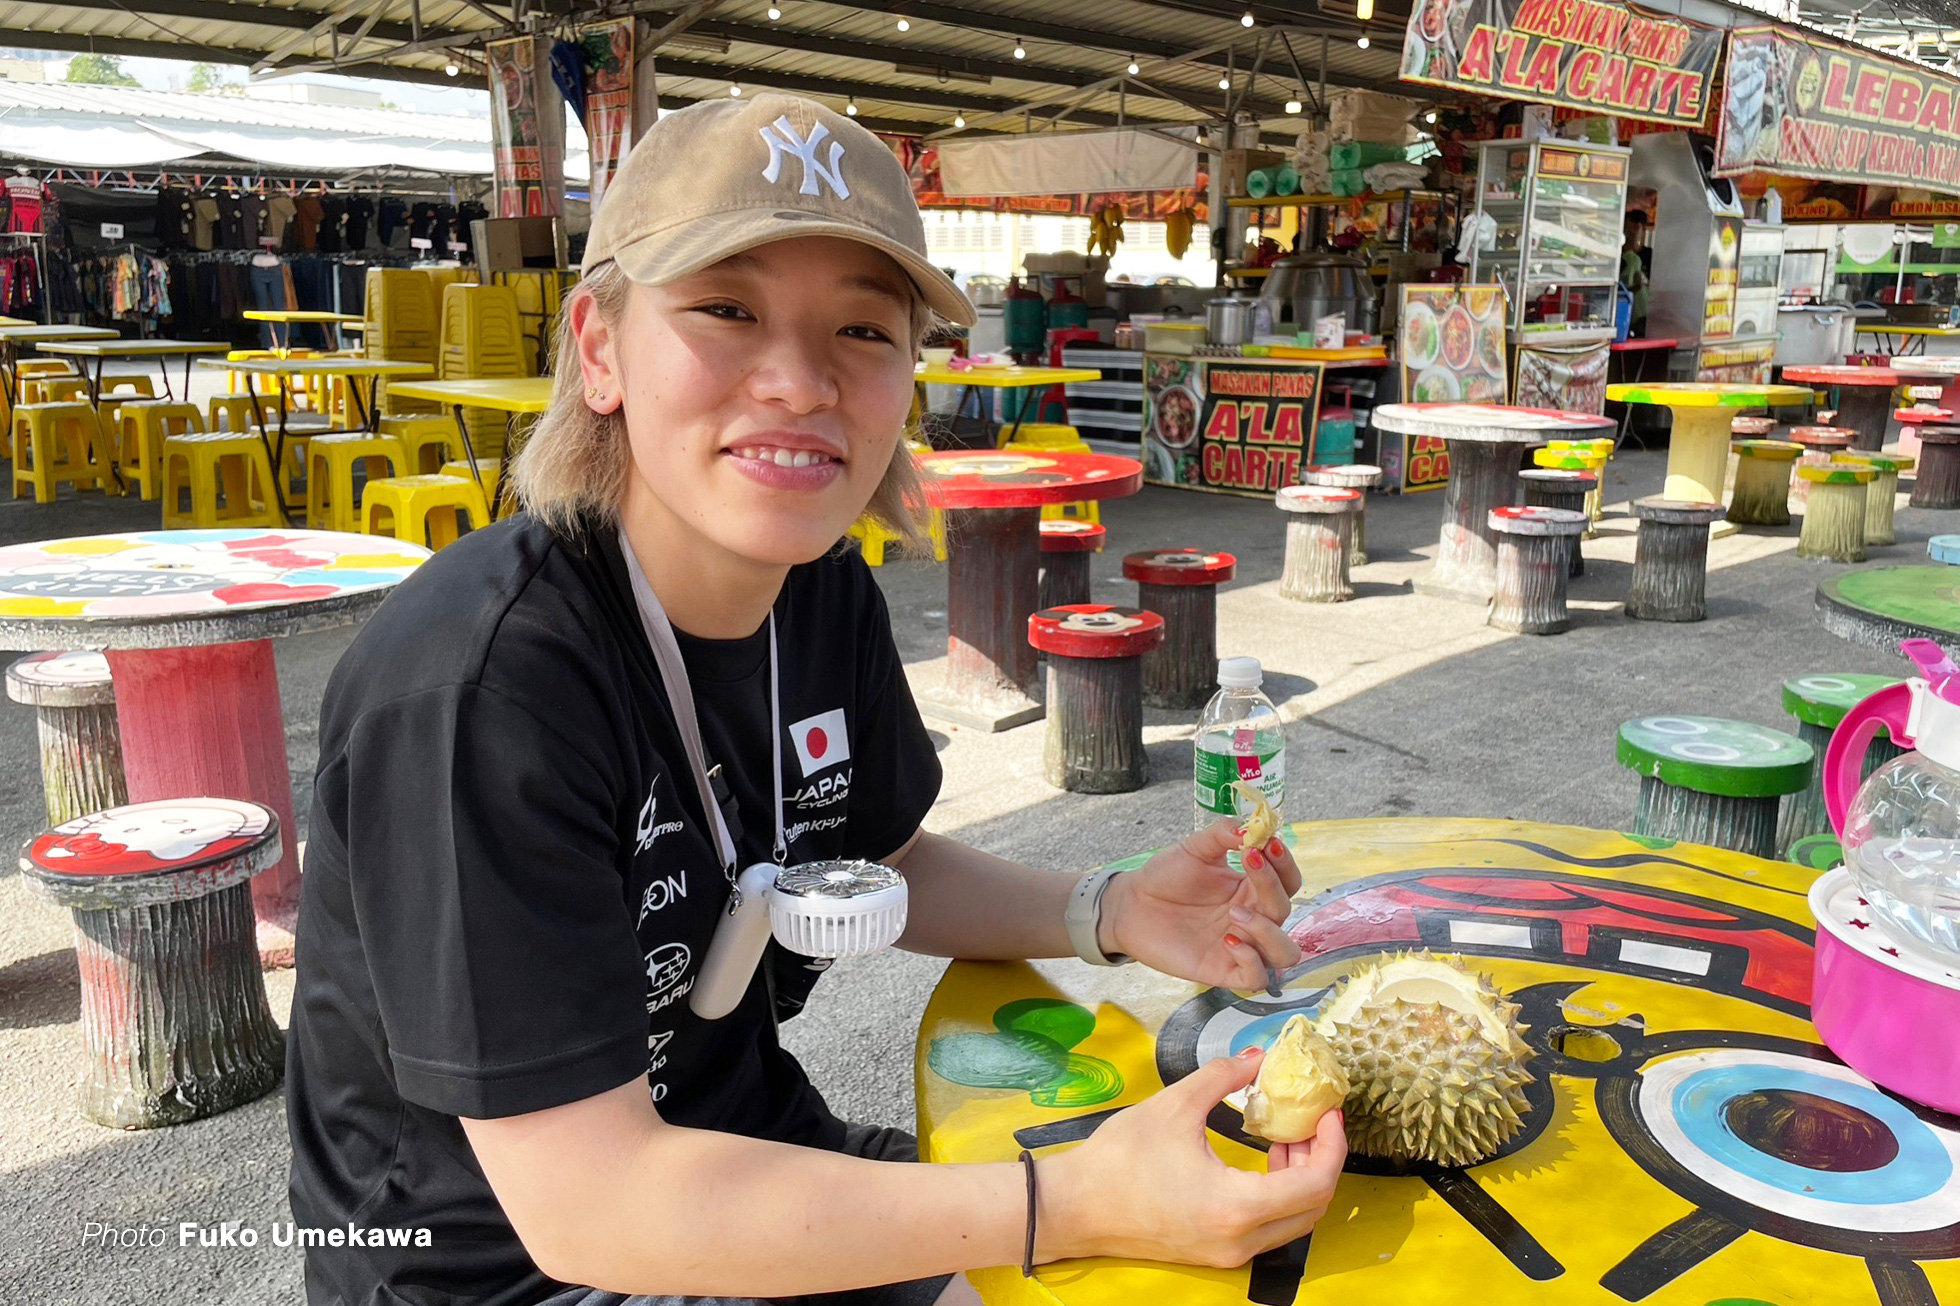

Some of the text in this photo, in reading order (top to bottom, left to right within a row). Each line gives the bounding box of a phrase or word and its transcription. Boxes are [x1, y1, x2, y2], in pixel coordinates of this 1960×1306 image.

[1458, 23, 1704, 118] A'LA CARTE
[1820, 55, 1960, 138] LEBA
[1834, 123, 1869, 173] SUP
[1210, 370, 1315, 398] MASAKAN PANAS
[1204, 400, 1303, 446] A'LA
[1203, 442, 1302, 491] CARTE
[12, 580, 193, 595] KITTY
[782, 768, 852, 802] JAPA
[797, 788, 849, 809] CYCLING
